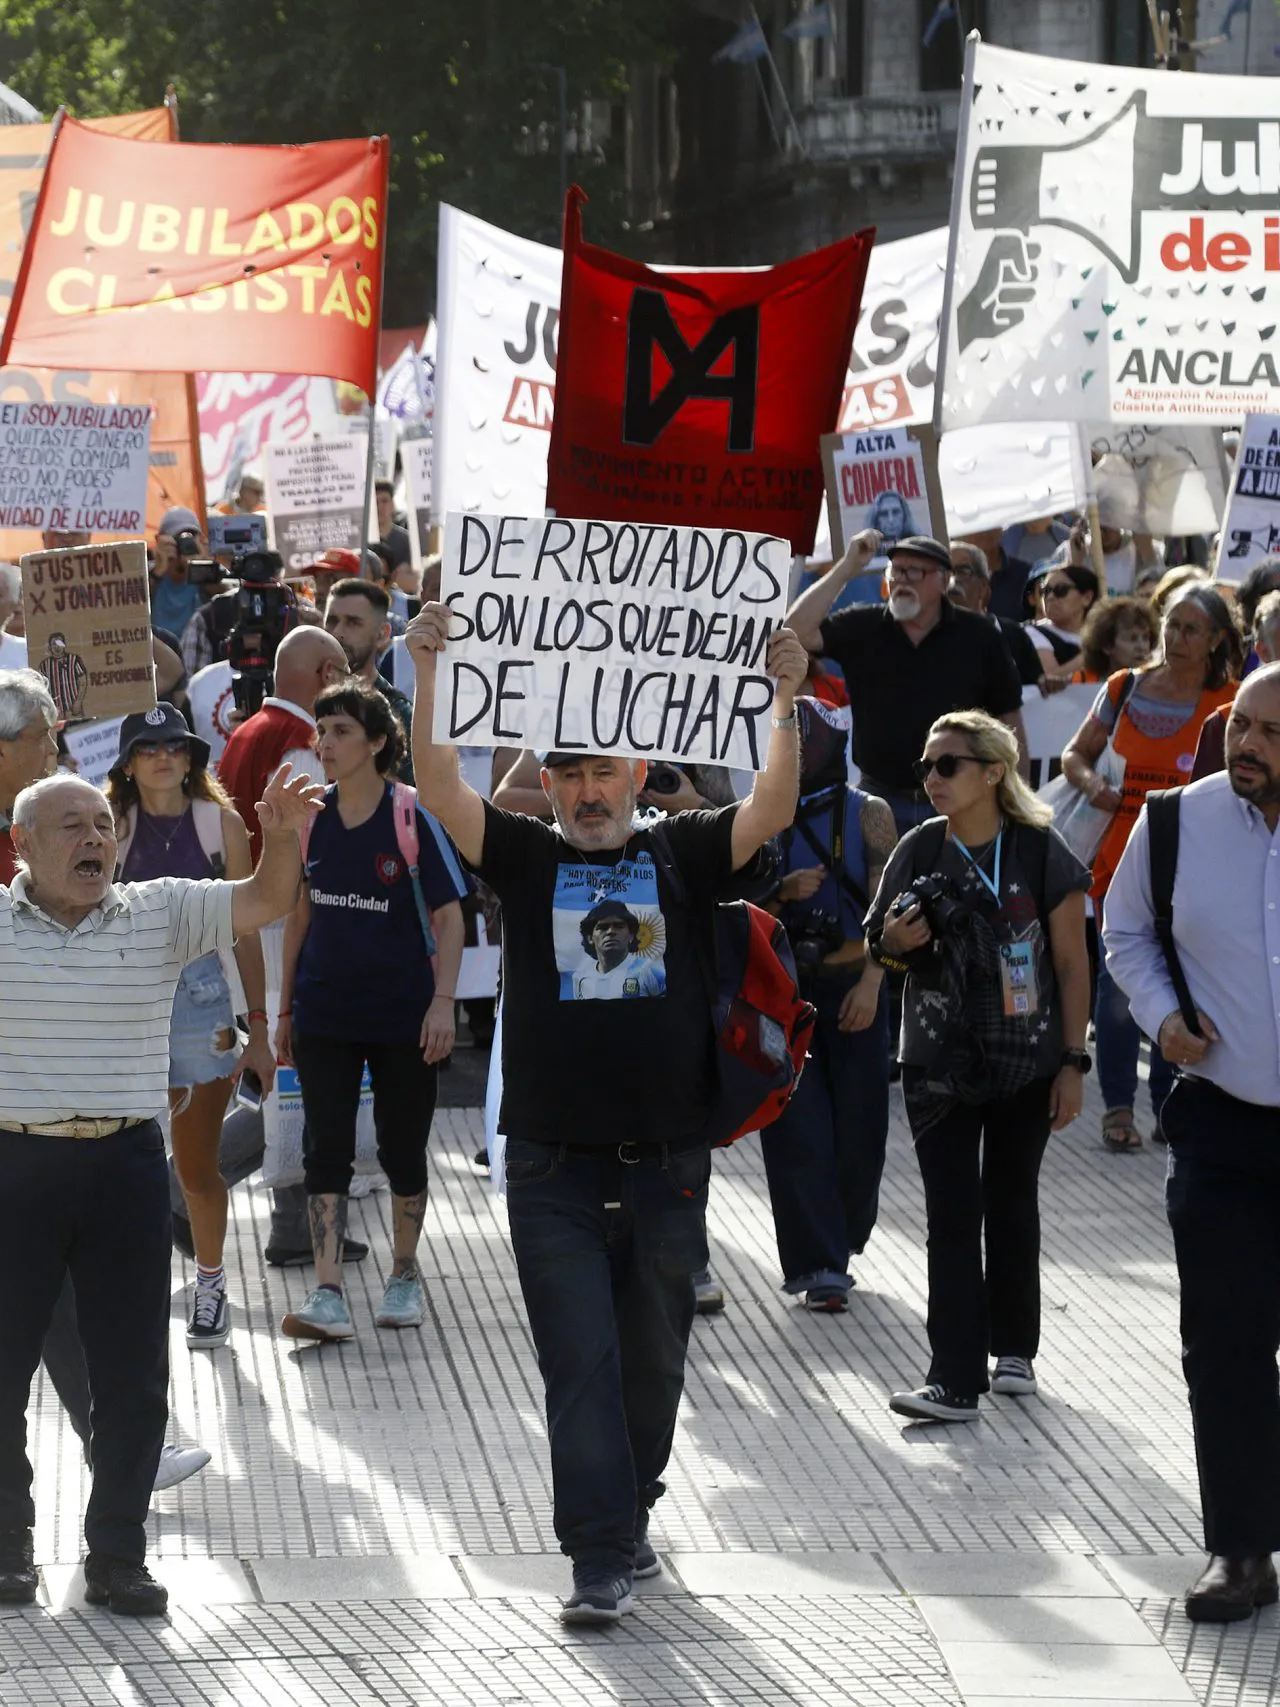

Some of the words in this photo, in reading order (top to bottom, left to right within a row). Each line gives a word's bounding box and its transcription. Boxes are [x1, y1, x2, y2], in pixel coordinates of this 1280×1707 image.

[50, 186, 379, 257] JUBILADOS
[1160, 217, 1252, 272] de
[45, 264, 373, 328] CLASISTAS
[1206, 389, 1269, 402] Nacional
[6, 427, 84, 448] QUITASTE
[86, 429, 145, 450] DINERO
[855, 434, 896, 455] ALTA
[70, 448, 131, 469] COMIDA
[1245, 446, 1264, 466] DE
[35, 469, 60, 486] NO
[63, 469, 115, 488] PODES
[81, 489, 104, 508] LA
[49, 508, 71, 529] DE
[76, 509, 141, 530] LUCHAR
[29, 550, 123, 585] JUSTICIA
[29, 590, 47, 615] X
[53, 576, 147, 612] JONATHAN
[445, 591, 529, 646] SON
[533, 596, 615, 653] LOS
[619, 602, 684, 656] QUE
[106, 650, 124, 666] ES
[449, 659, 536, 739] DE
[554, 660, 776, 771] LUCHAR
[314, 888, 347, 907] Banco
[347, 893, 390, 913] Ciudad
